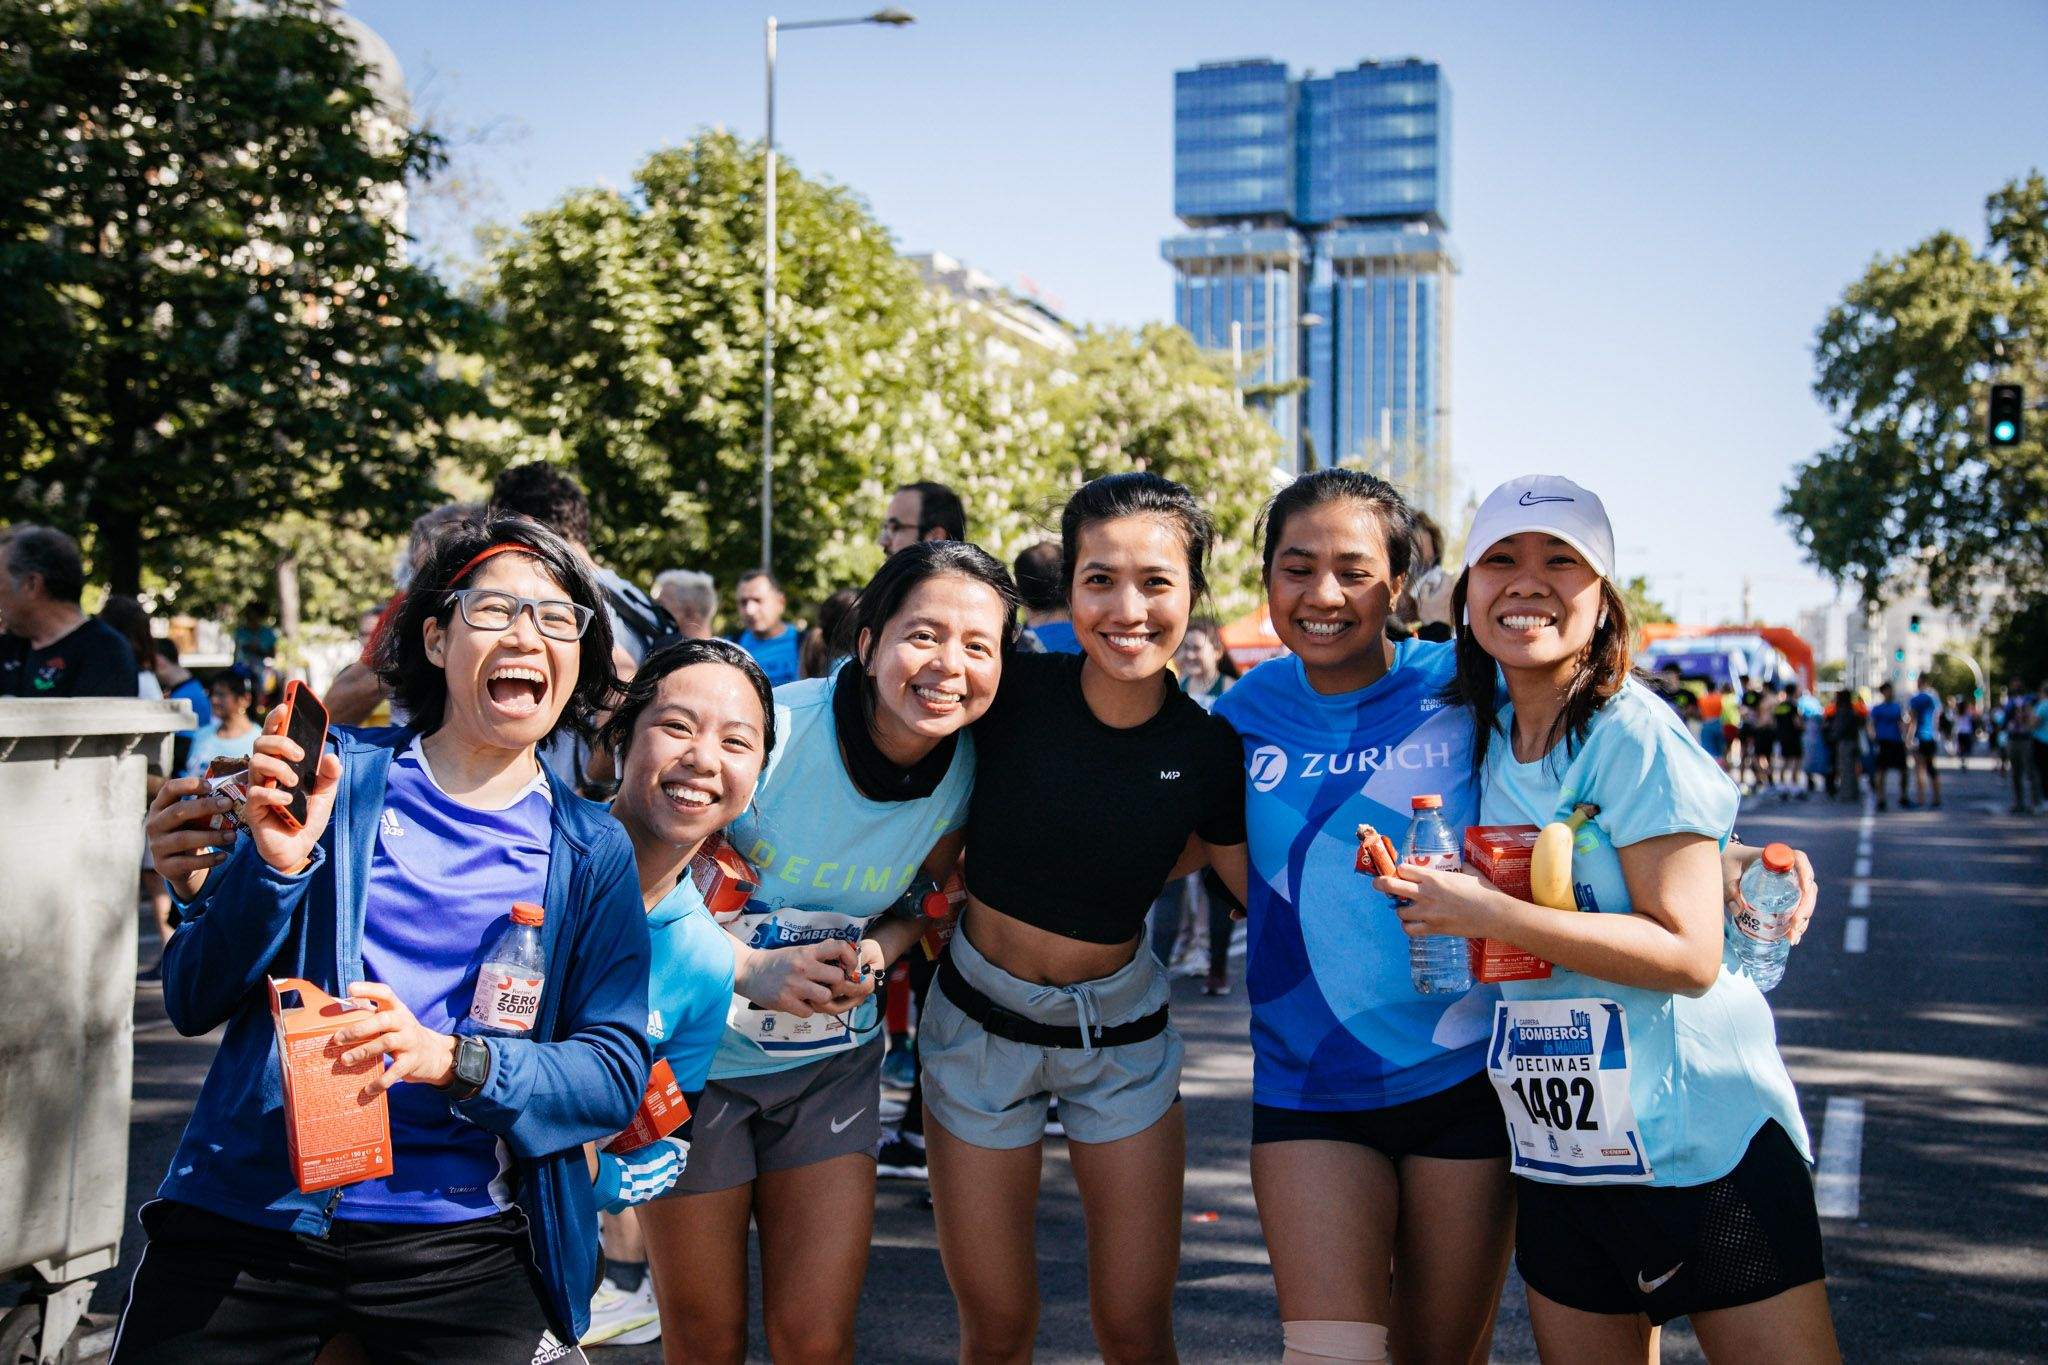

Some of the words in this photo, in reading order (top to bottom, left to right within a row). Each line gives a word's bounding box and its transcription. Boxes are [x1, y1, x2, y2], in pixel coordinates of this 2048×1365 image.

[1299, 742, 1450, 778] ZURICH
[1160, 770, 1181, 780] MP
[749, 838, 915, 893] DECIMA
[779, 927, 848, 943] BOMBERO
[500, 992, 537, 1005] ZERO
[497, 1002, 535, 1014] SODIO
[1519, 1026, 1589, 1041] BOMBEROS
[1543, 1042, 1555, 1055] de
[1556, 1040, 1590, 1055] MADRID
[1516, 1057, 1591, 1072] DECIMAS
[1510, 1076, 1599, 1131] 1482
[531, 1345, 571, 1365] adidas
